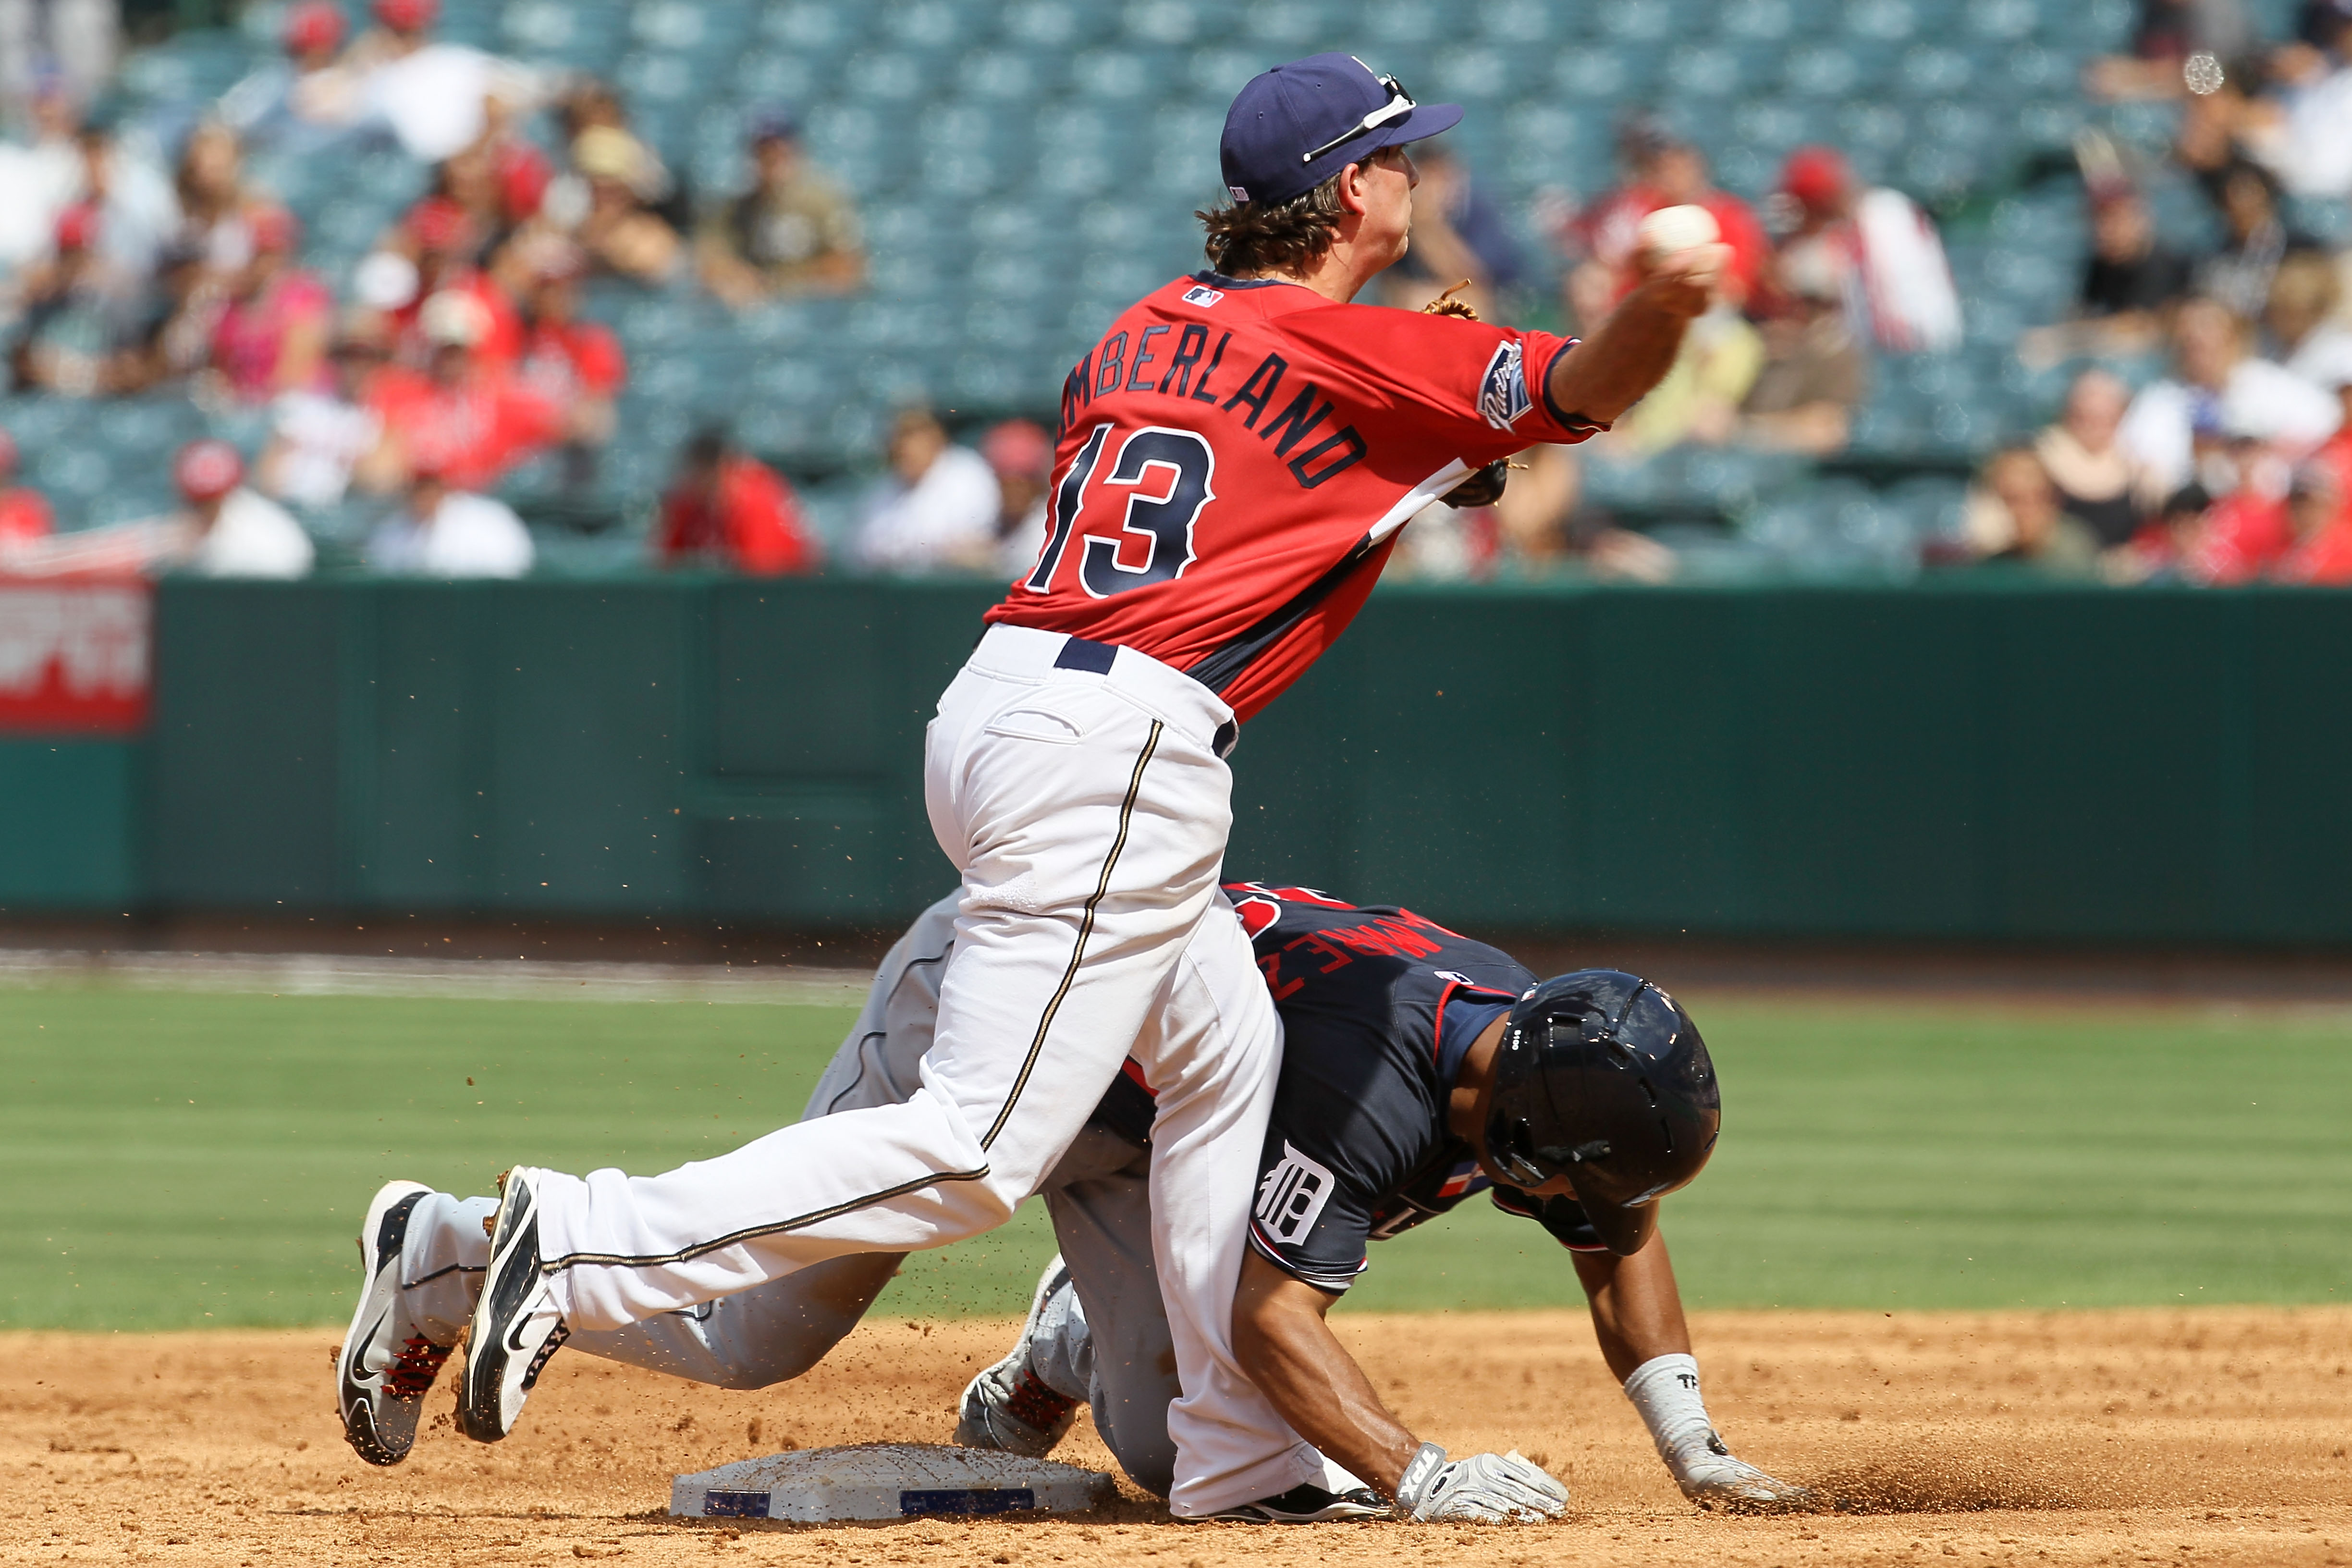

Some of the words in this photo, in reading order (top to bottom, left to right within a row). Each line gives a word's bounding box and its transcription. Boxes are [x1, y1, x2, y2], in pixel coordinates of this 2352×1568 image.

[1054, 324, 1367, 489] MBERLAND
[1024, 422, 1216, 600] 13
[1398, 1449, 1438, 1501] TPX
